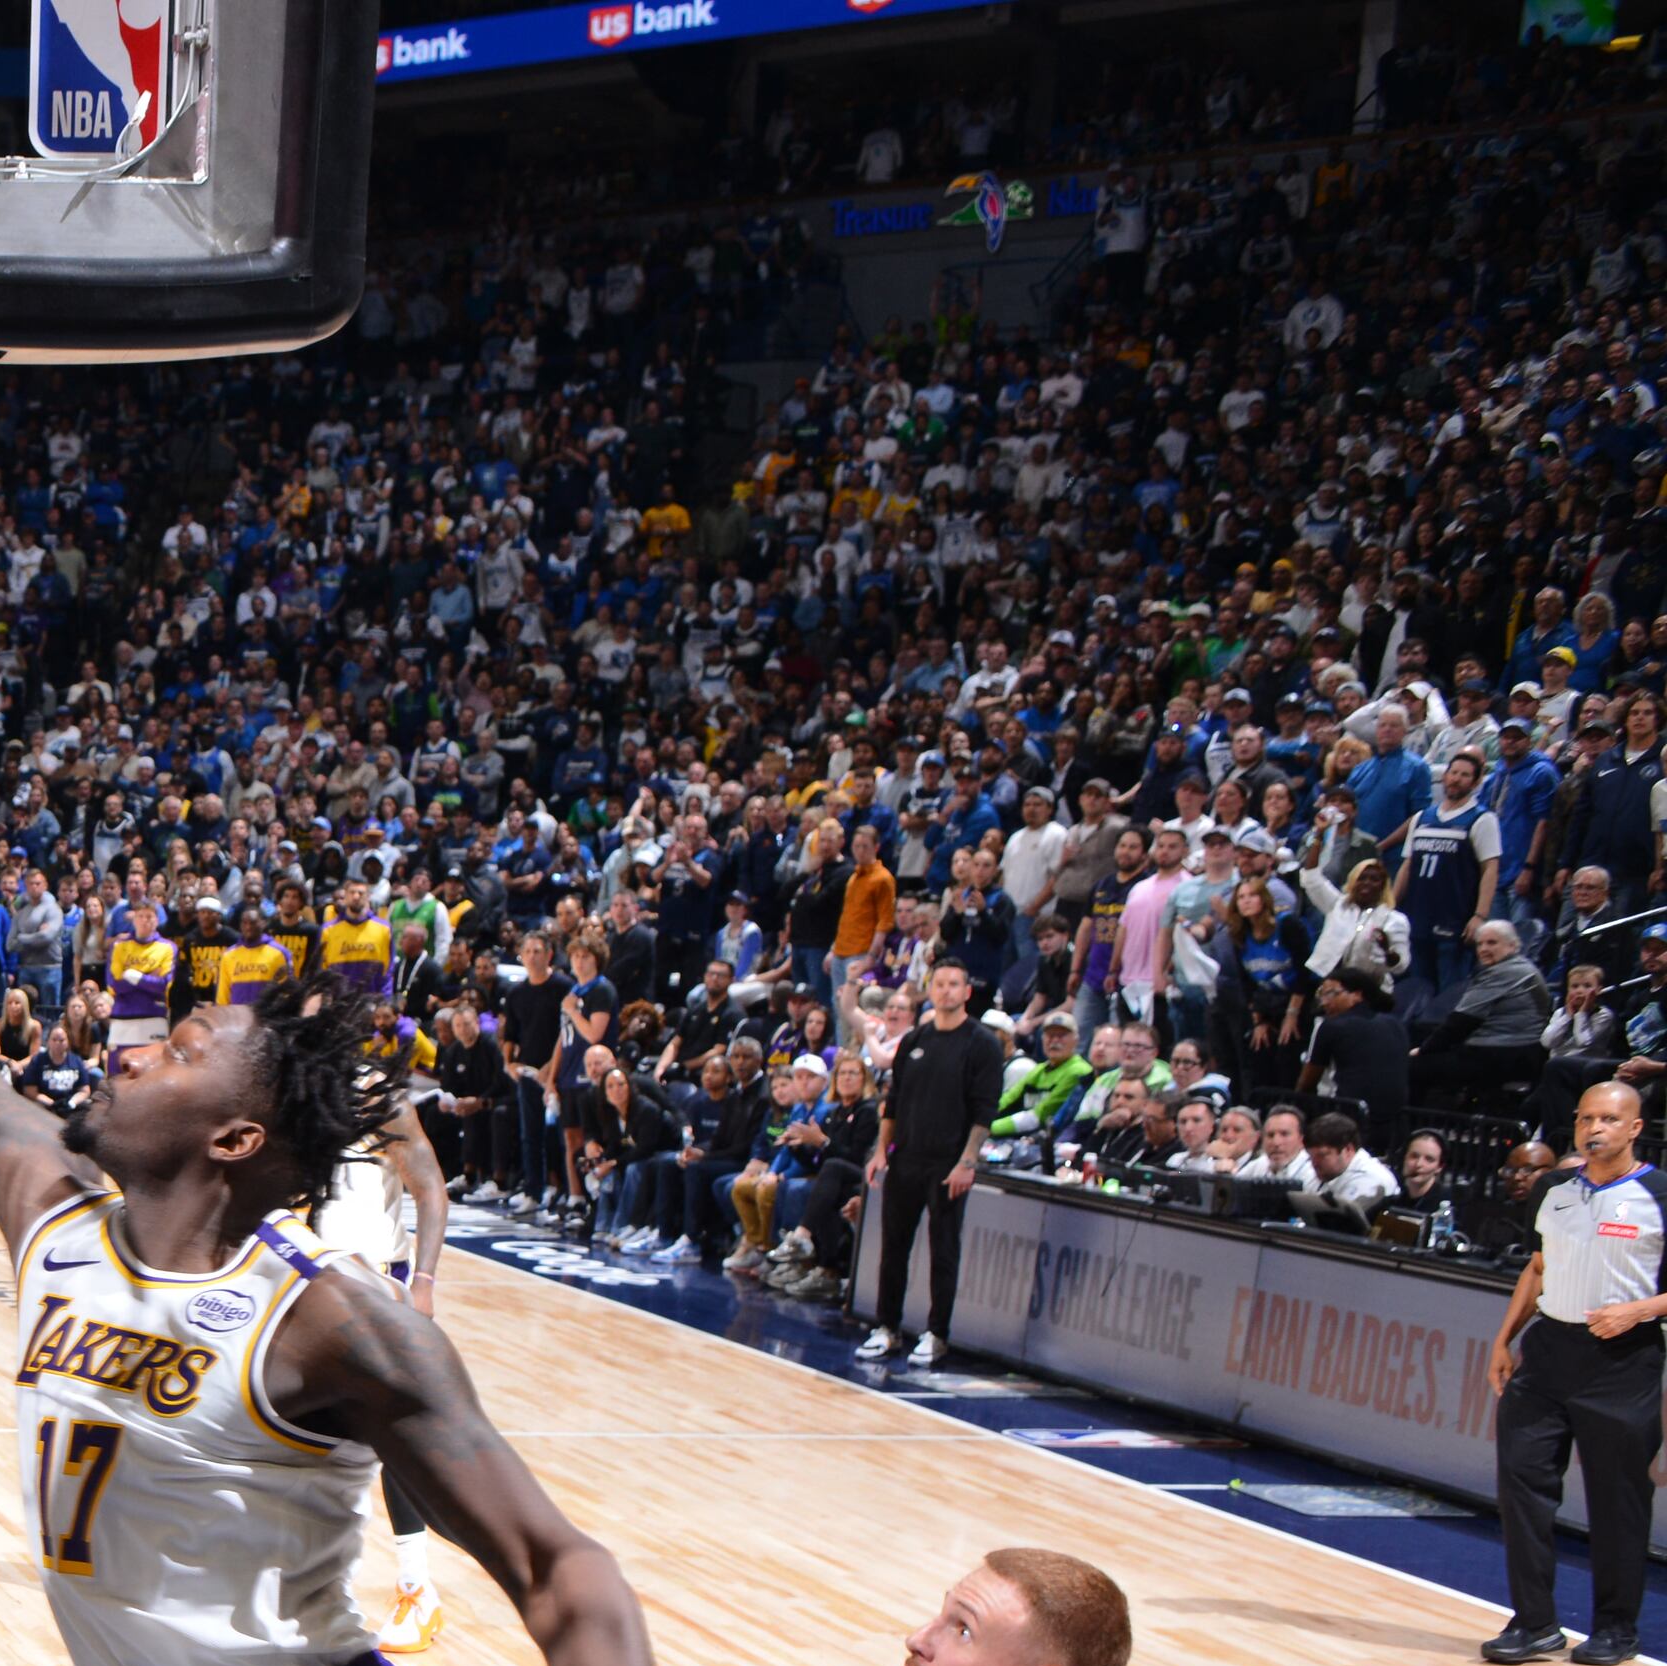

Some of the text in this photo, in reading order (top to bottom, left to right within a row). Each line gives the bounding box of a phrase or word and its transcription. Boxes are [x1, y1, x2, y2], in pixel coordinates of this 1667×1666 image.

[51, 90, 113, 138] NBA
[16, 1292, 218, 1418] LAKERS
[194, 1295, 251, 1323] bibigo
[1223, 1285, 1312, 1391] EARN
[36, 1416, 125, 1577] 17
